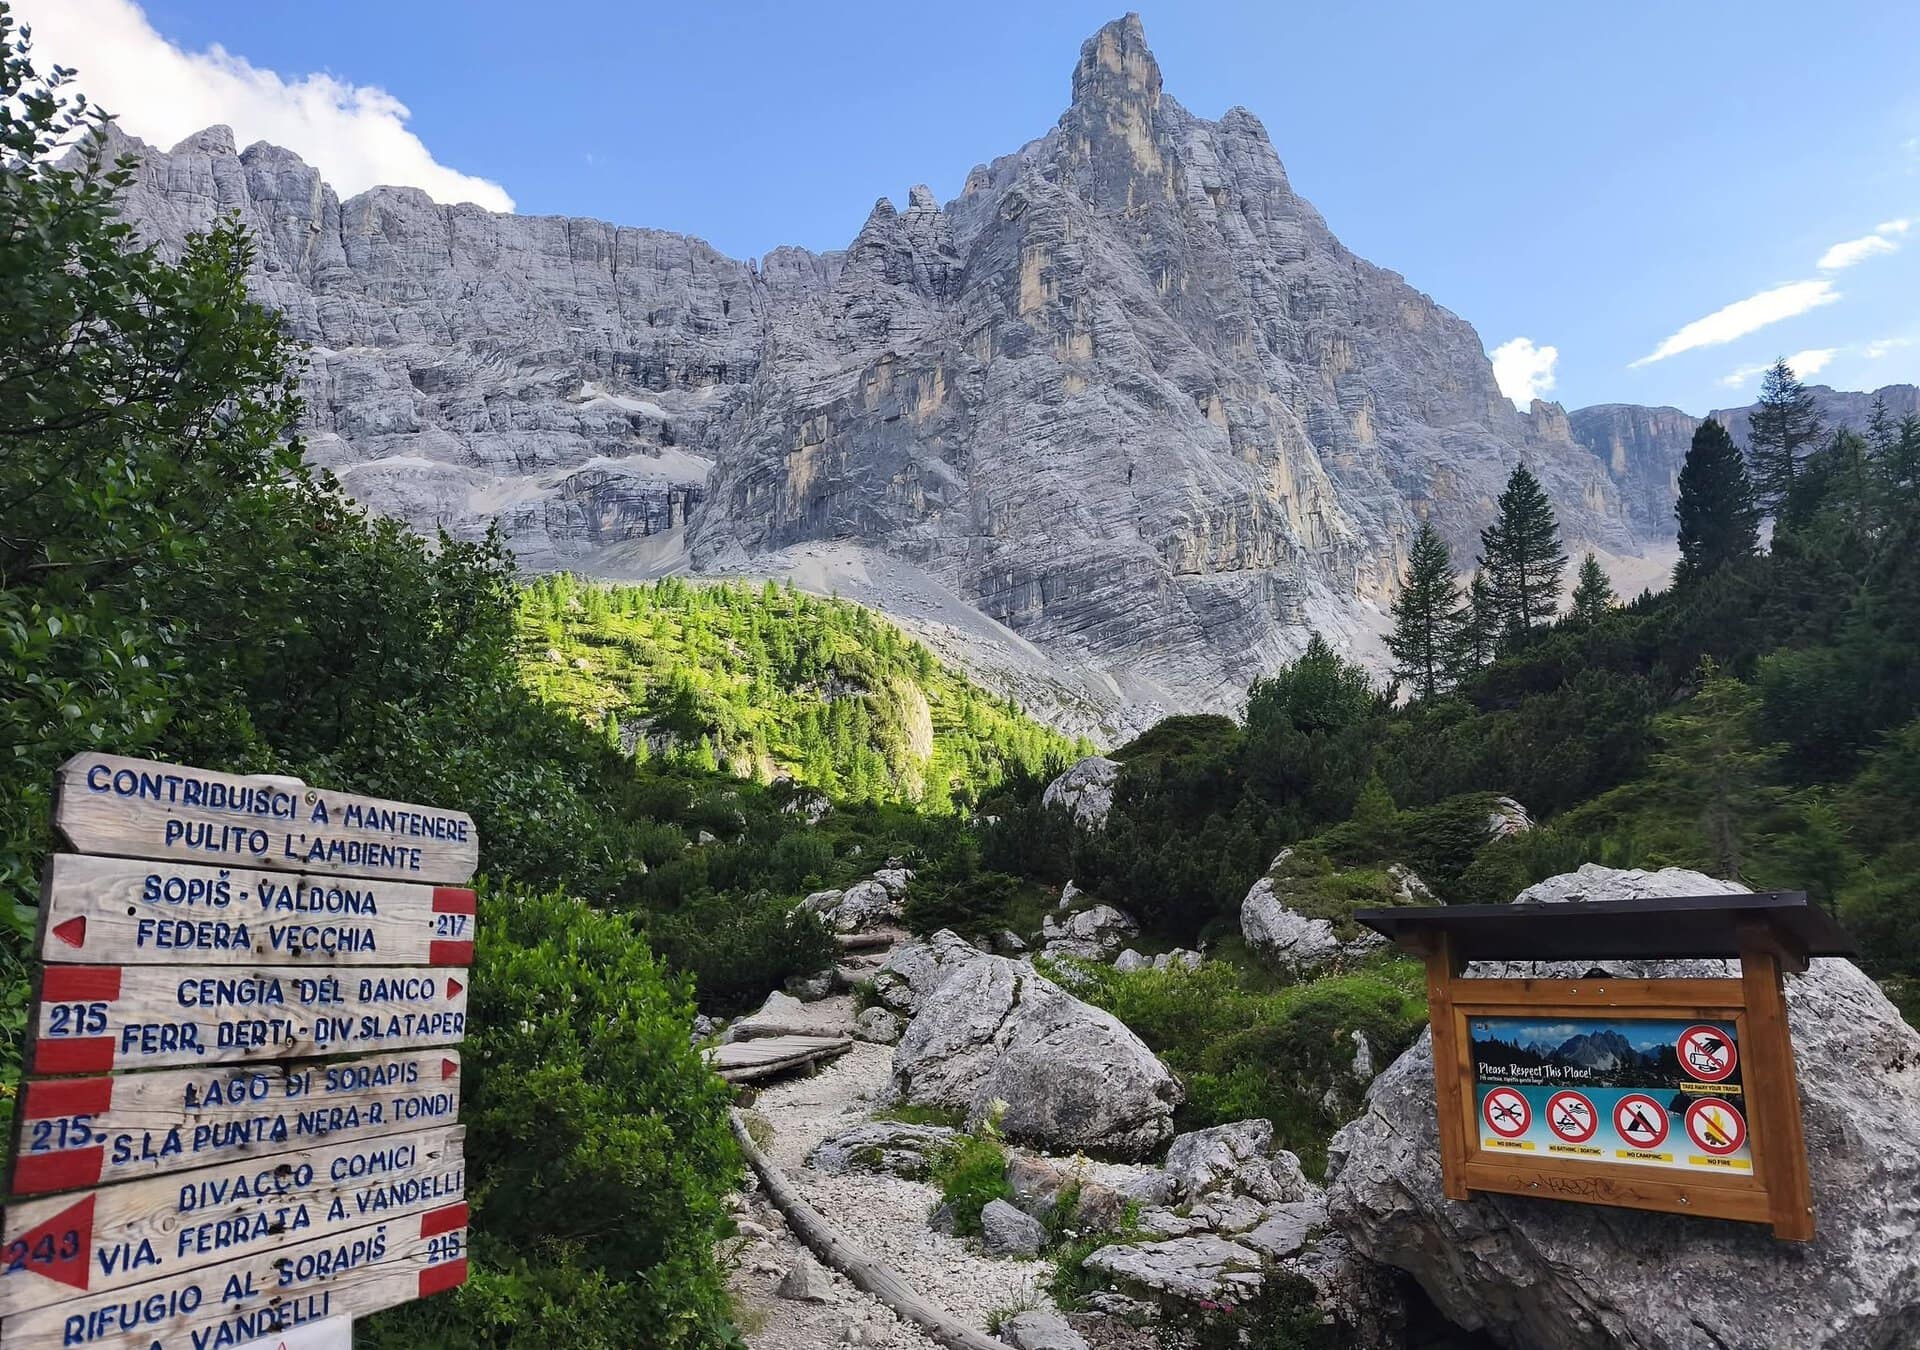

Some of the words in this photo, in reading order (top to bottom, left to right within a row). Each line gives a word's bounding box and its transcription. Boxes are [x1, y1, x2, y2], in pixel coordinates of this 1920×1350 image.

[87, 764, 297, 820] CONTRIBUISCI
[311, 799, 329, 825] A
[344, 804, 468, 843] MANTENERE
[165, 820, 269, 856] PULITO
[285, 833, 422, 872] L'AMBIENTE
[142, 869, 231, 909] SOPIŠ
[137, 919, 251, 950] FEDERA
[269, 925, 377, 953] VECCHIA
[437, 914, 467, 937] 217
[177, 977, 285, 1008] CENGIA
[300, 978, 345, 1006] DEL
[359, 976, 435, 1004] BANCO
[49, 1002, 109, 1036] 215
[122, 1022, 206, 1055] FERR.
[184, 1074, 269, 1109] LAGO
[285, 1071, 311, 1097] DI
[325, 1061, 418, 1093] SORAPIS
[1510, 1063, 1541, 1078] Respect
[1543, 1063, 1561, 1078] This
[1563, 1065, 1592, 1079] Place!
[193, 1114, 288, 1151] PUNTA
[391, 1093, 453, 1121] TONDI
[331, 1144, 415, 1180] COMICI
[98, 1238, 162, 1277] VIA.
[178, 1203, 310, 1258] FERRATA
[356, 1170, 460, 1214] VANDELLI
[5, 1230, 80, 1277] 243
[428, 1231, 461, 1264] 215
[63, 1284, 202, 1347] RIFUGIO
[222, 1271, 259, 1303] AL
[191, 1290, 329, 1350] VANDELLI
